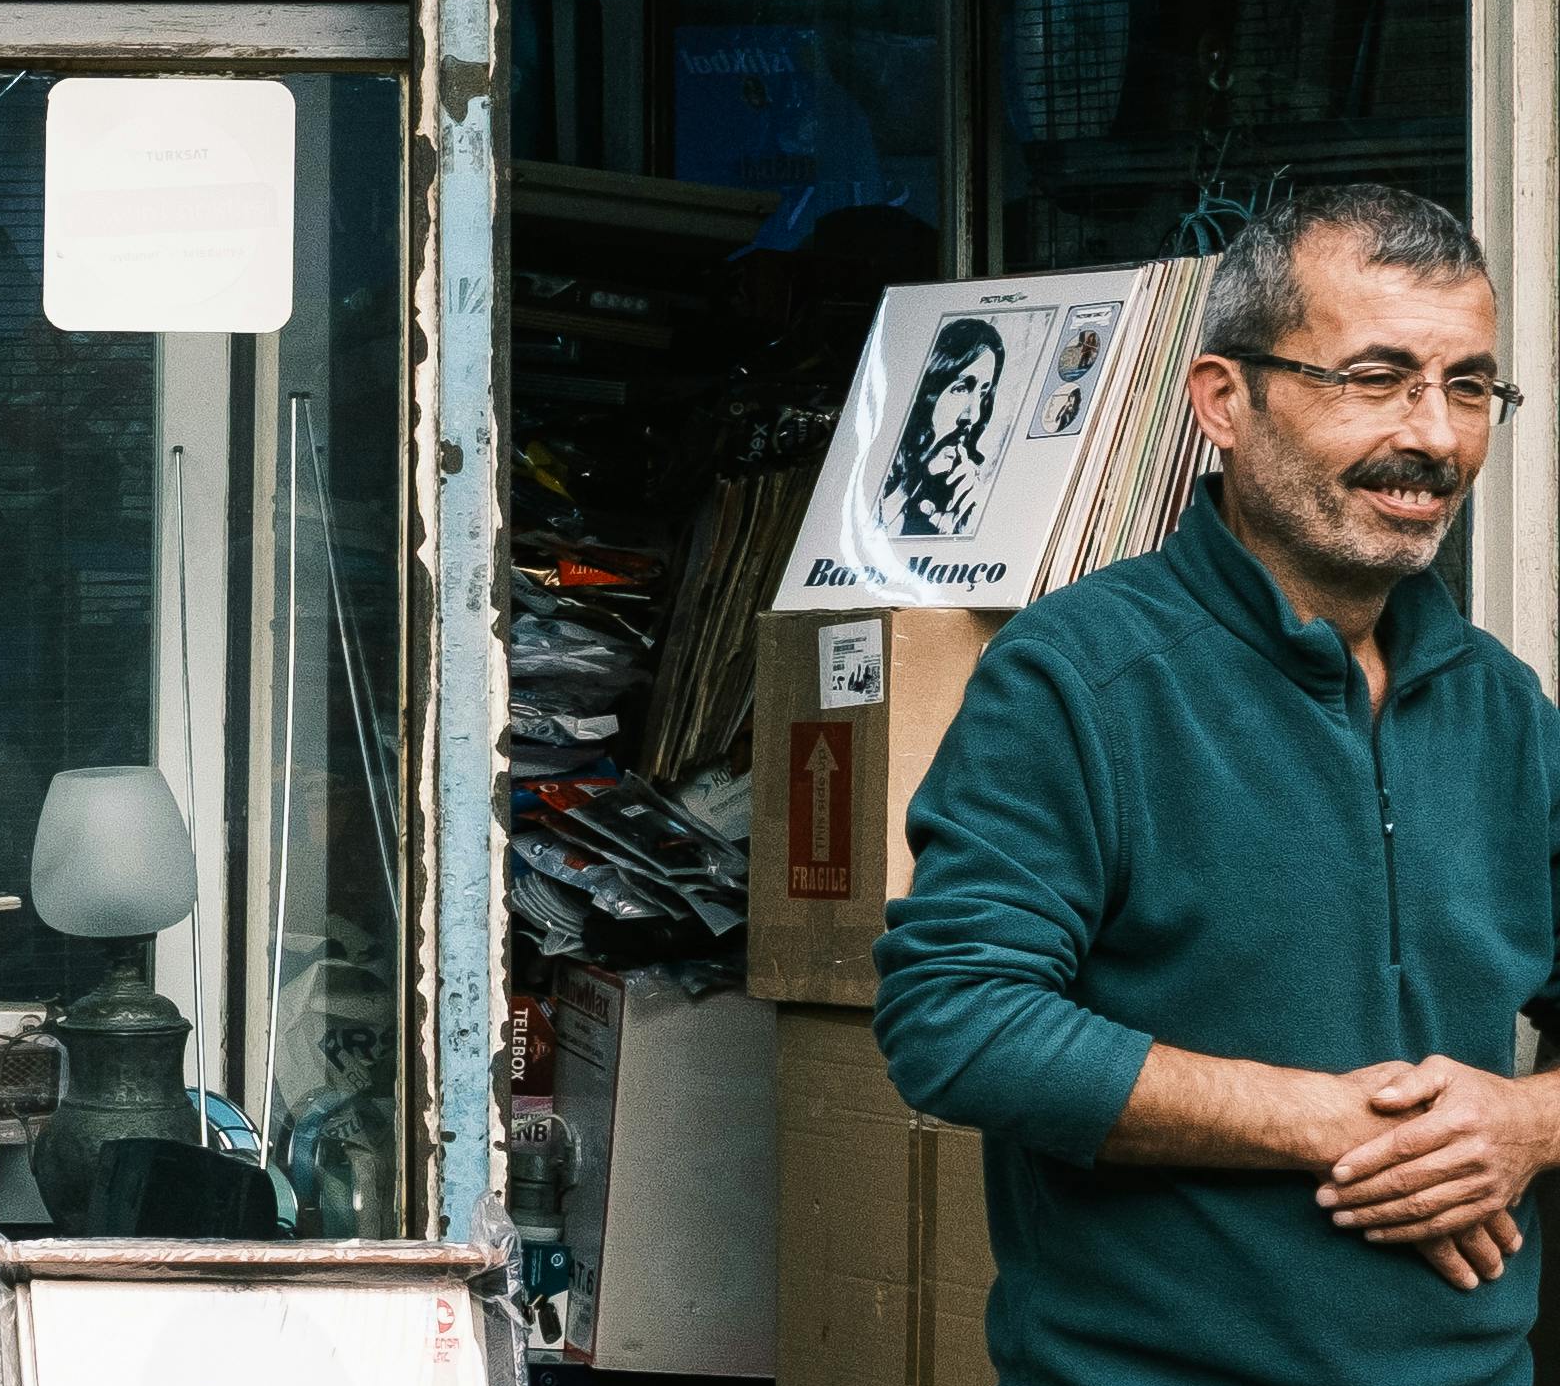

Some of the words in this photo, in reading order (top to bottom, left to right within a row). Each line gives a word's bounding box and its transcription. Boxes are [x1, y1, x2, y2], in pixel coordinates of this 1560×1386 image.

[144, 148, 210, 162] TURKSAT
[791, 865, 849, 893] FRAGILE
[512, 1007, 530, 1082] TELEBOX
